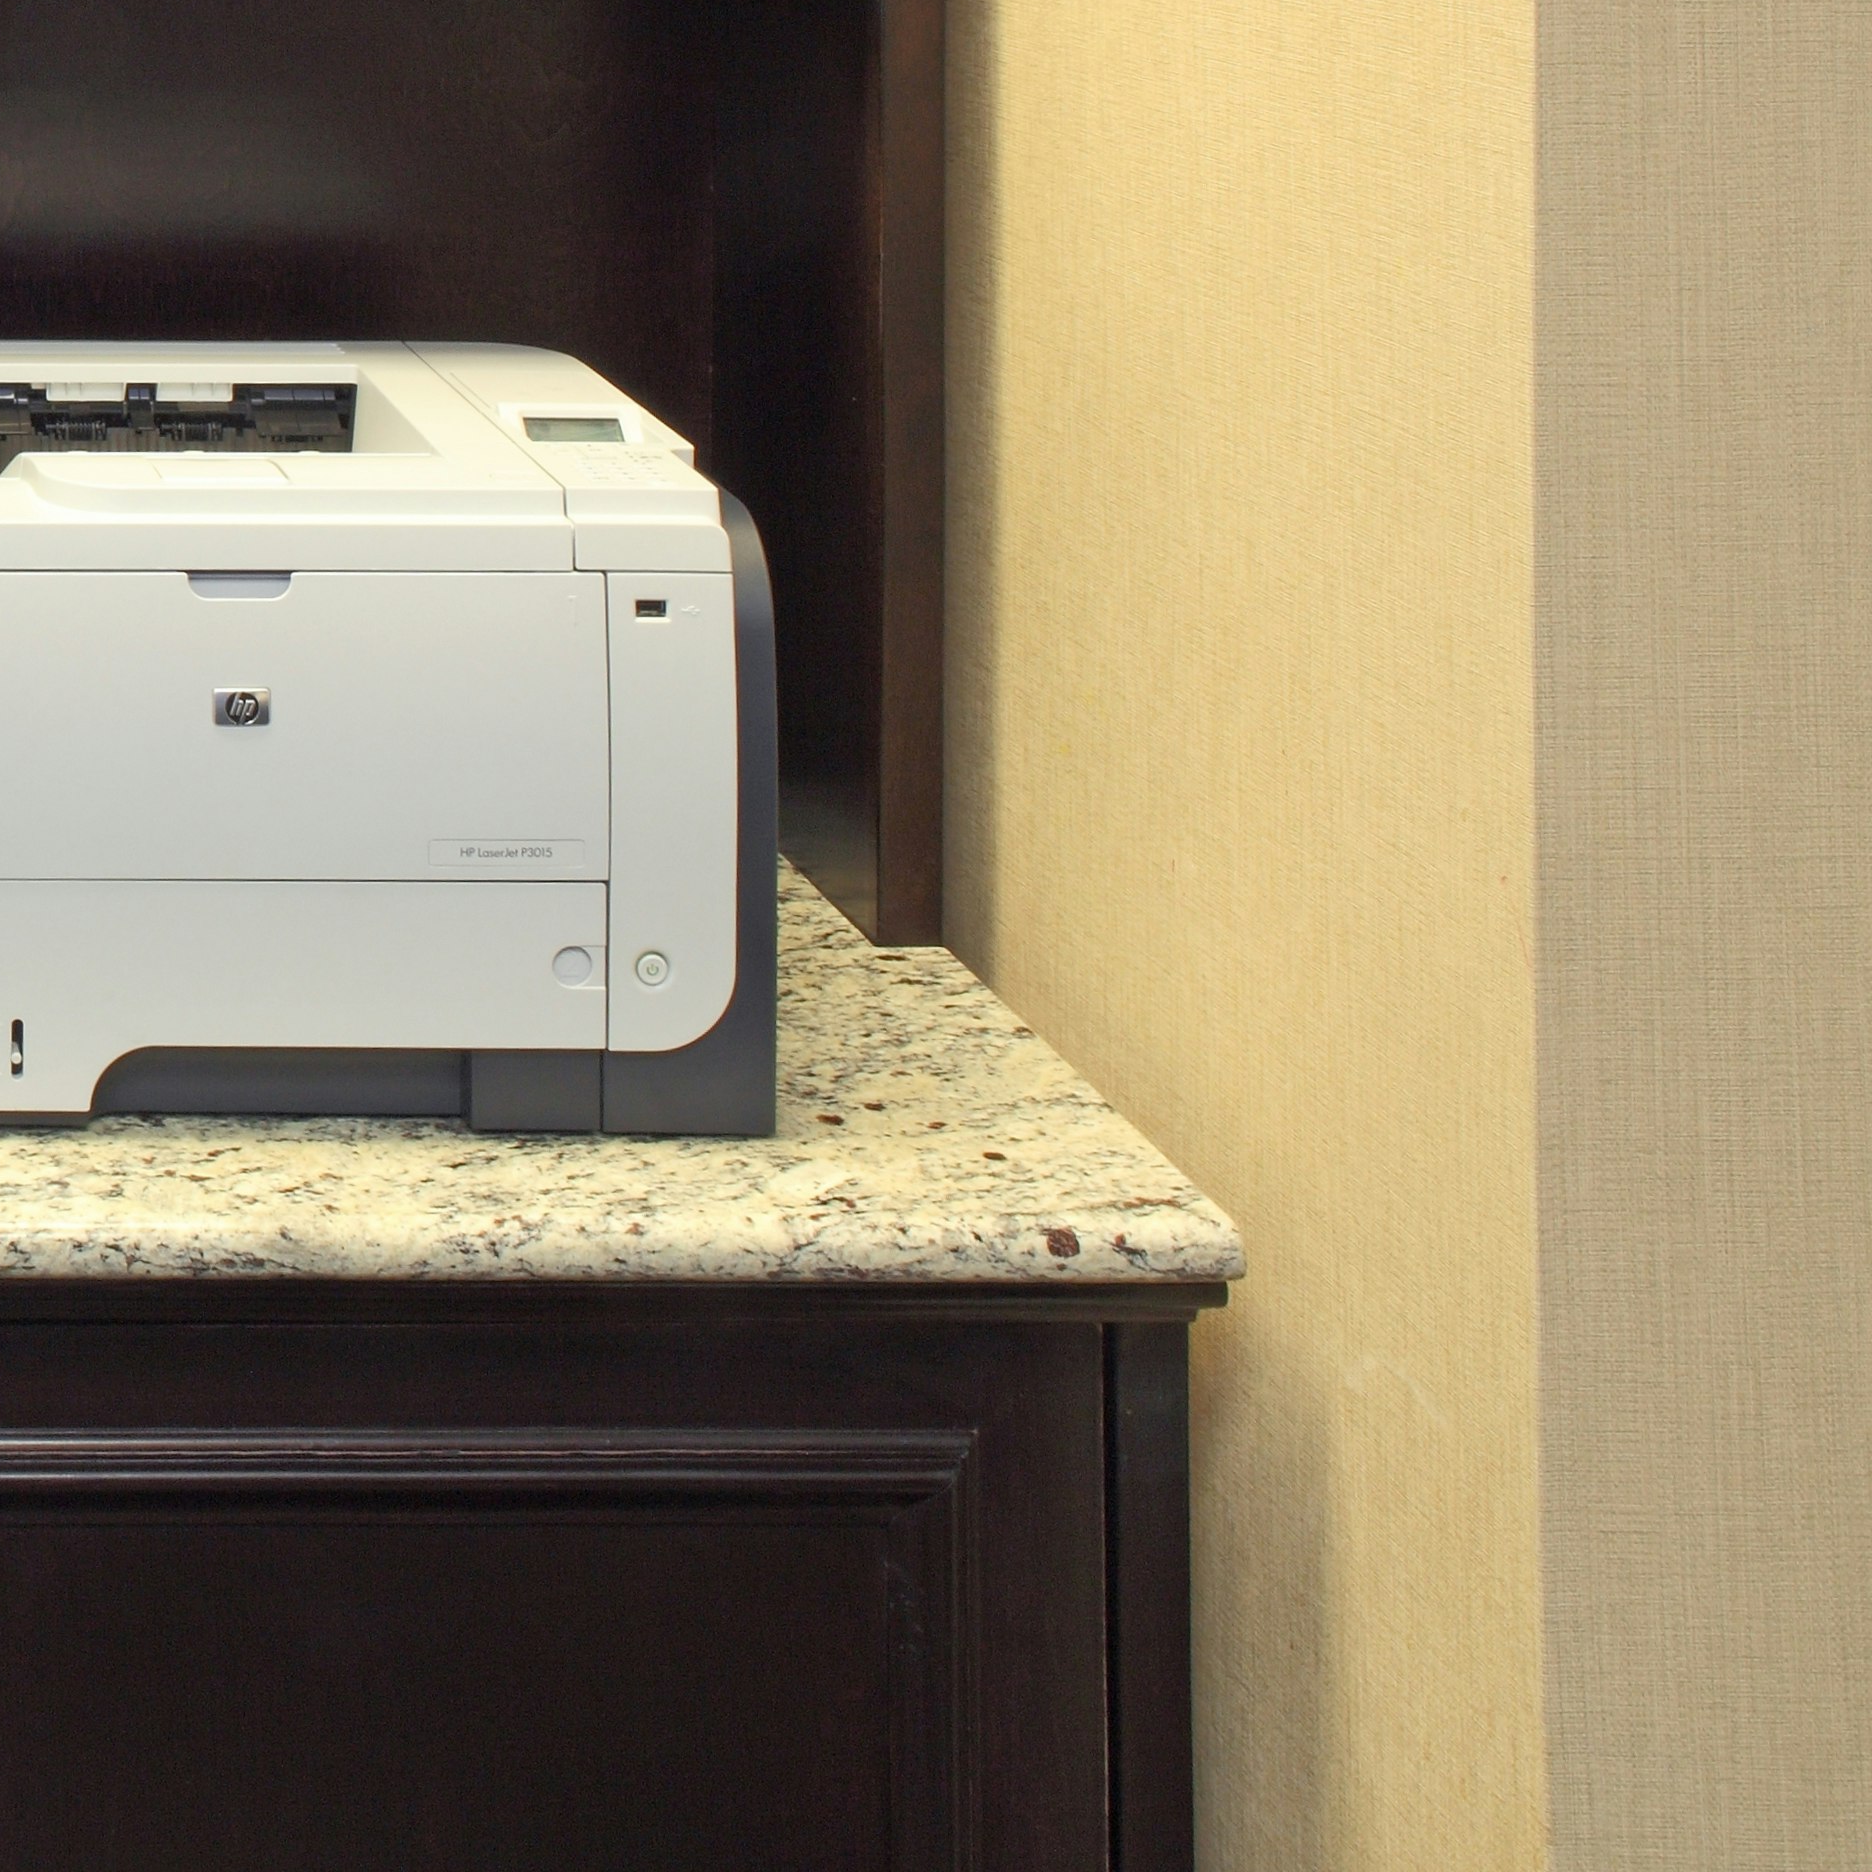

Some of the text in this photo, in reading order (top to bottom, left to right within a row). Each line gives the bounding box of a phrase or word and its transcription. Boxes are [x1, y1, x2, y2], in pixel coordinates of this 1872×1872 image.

[230, 692, 255, 724] hp
[460, 847, 552, 857] HP LaserJet P3015
